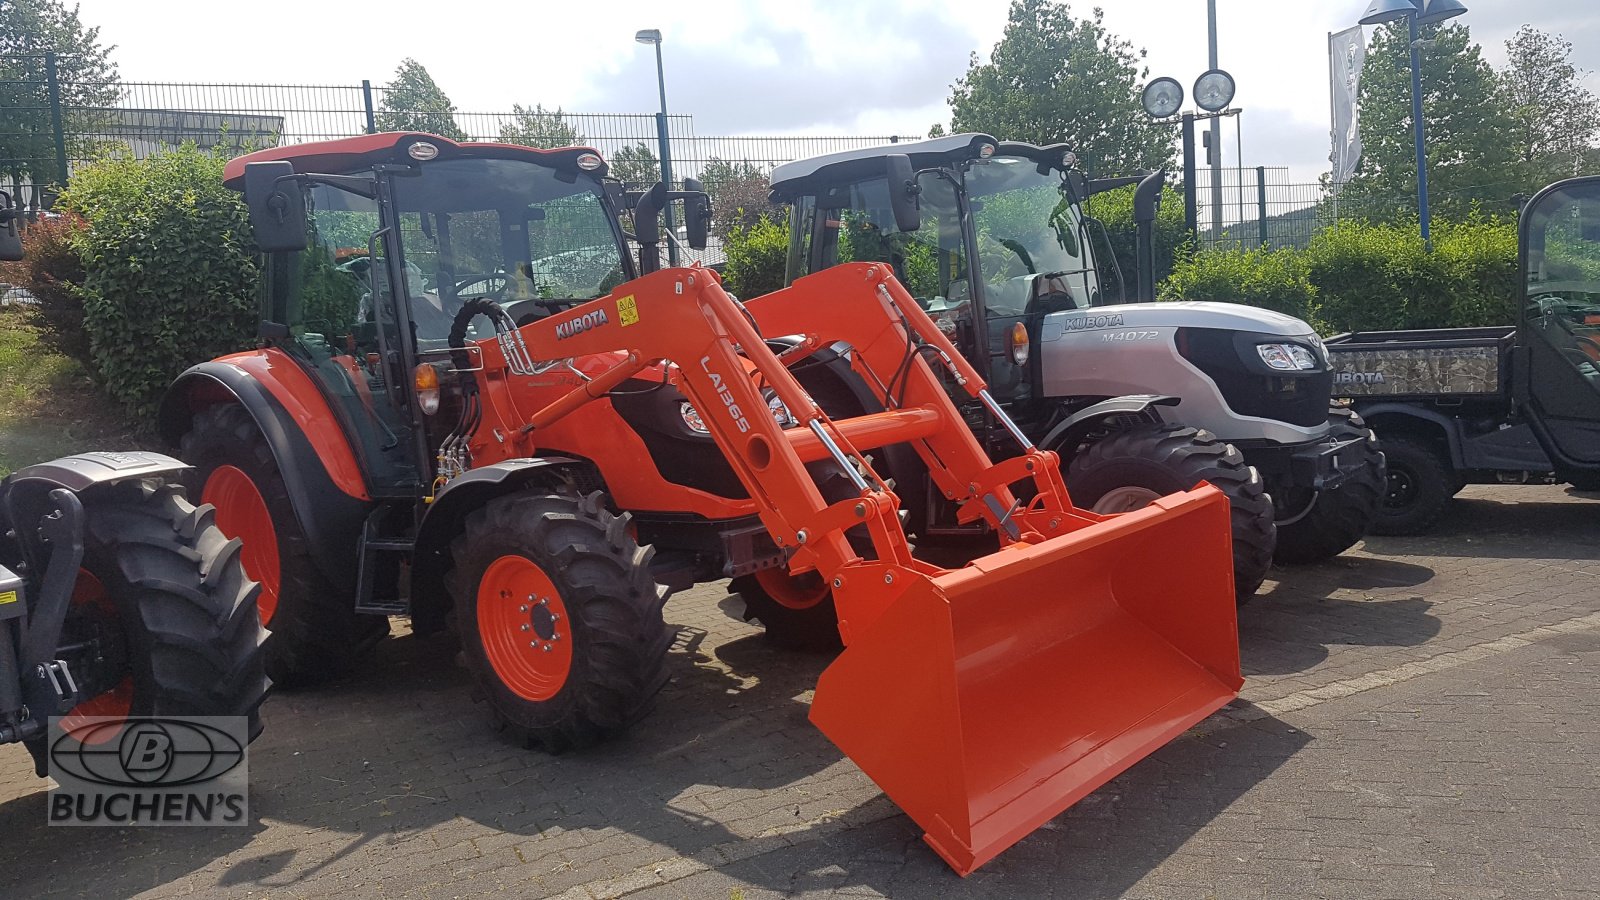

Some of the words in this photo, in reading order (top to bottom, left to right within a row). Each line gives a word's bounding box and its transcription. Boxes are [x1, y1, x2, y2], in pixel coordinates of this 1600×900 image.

[555, 308, 608, 340] KUBOTA
[1064, 314, 1124, 330] KUBOTA
[1102, 331, 1159, 342] M4072
[1333, 372, 1385, 384] UBOTA
[700, 355, 751, 433] LA1365
